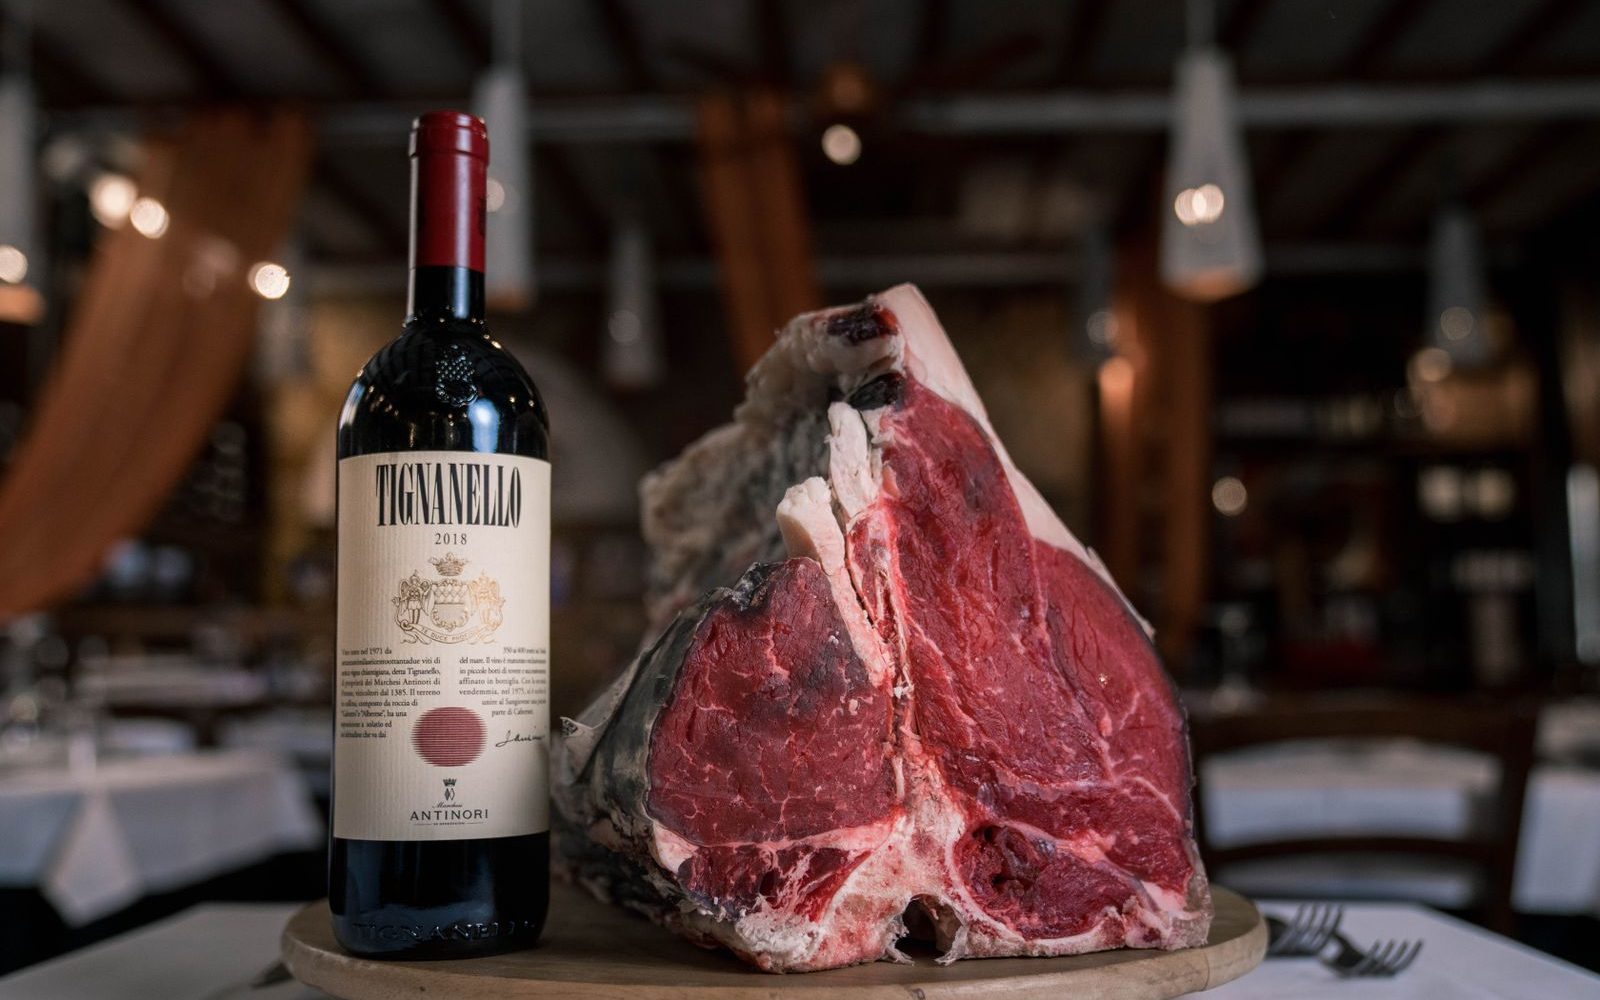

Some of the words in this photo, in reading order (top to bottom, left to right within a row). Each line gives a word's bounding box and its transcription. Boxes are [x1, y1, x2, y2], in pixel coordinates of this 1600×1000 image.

[375, 463, 521, 528] TIGNANELLO
[435, 533, 467, 545] 2018
[369, 647, 383, 655] 1971
[434, 656, 441, 664] di
[460, 656, 468, 664] del
[402, 678, 431, 686] Antinori
[433, 677, 440, 686] di
[459, 677, 485, 685] affinato
[410, 688, 415, 696] Il
[387, 709, 394, 717] ha
[385, 720, 392, 728] ed
[410, 809, 488, 821] ANTINORI
